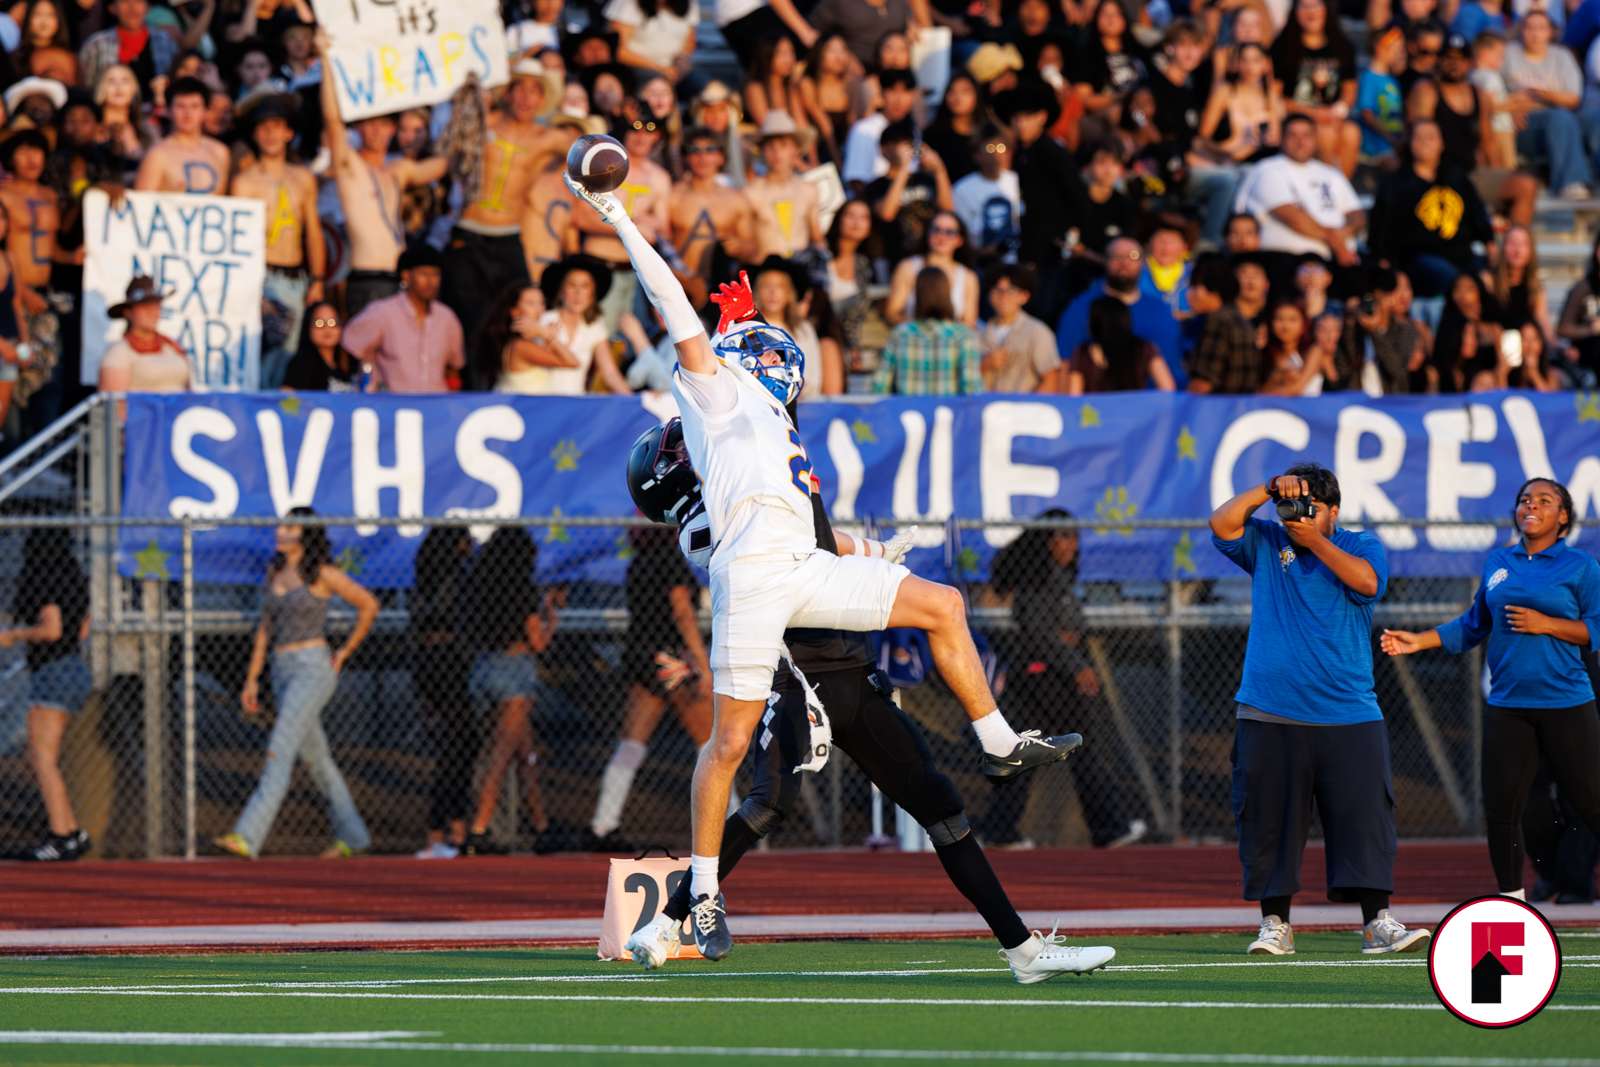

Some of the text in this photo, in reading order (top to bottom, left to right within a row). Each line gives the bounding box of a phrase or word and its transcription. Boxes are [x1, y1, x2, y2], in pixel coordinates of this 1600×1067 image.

[333, 25, 492, 105] WRAPS
[103, 198, 254, 256] MAYBE
[177, 318, 248, 386] AR!
[168, 405, 526, 543] SVHS
